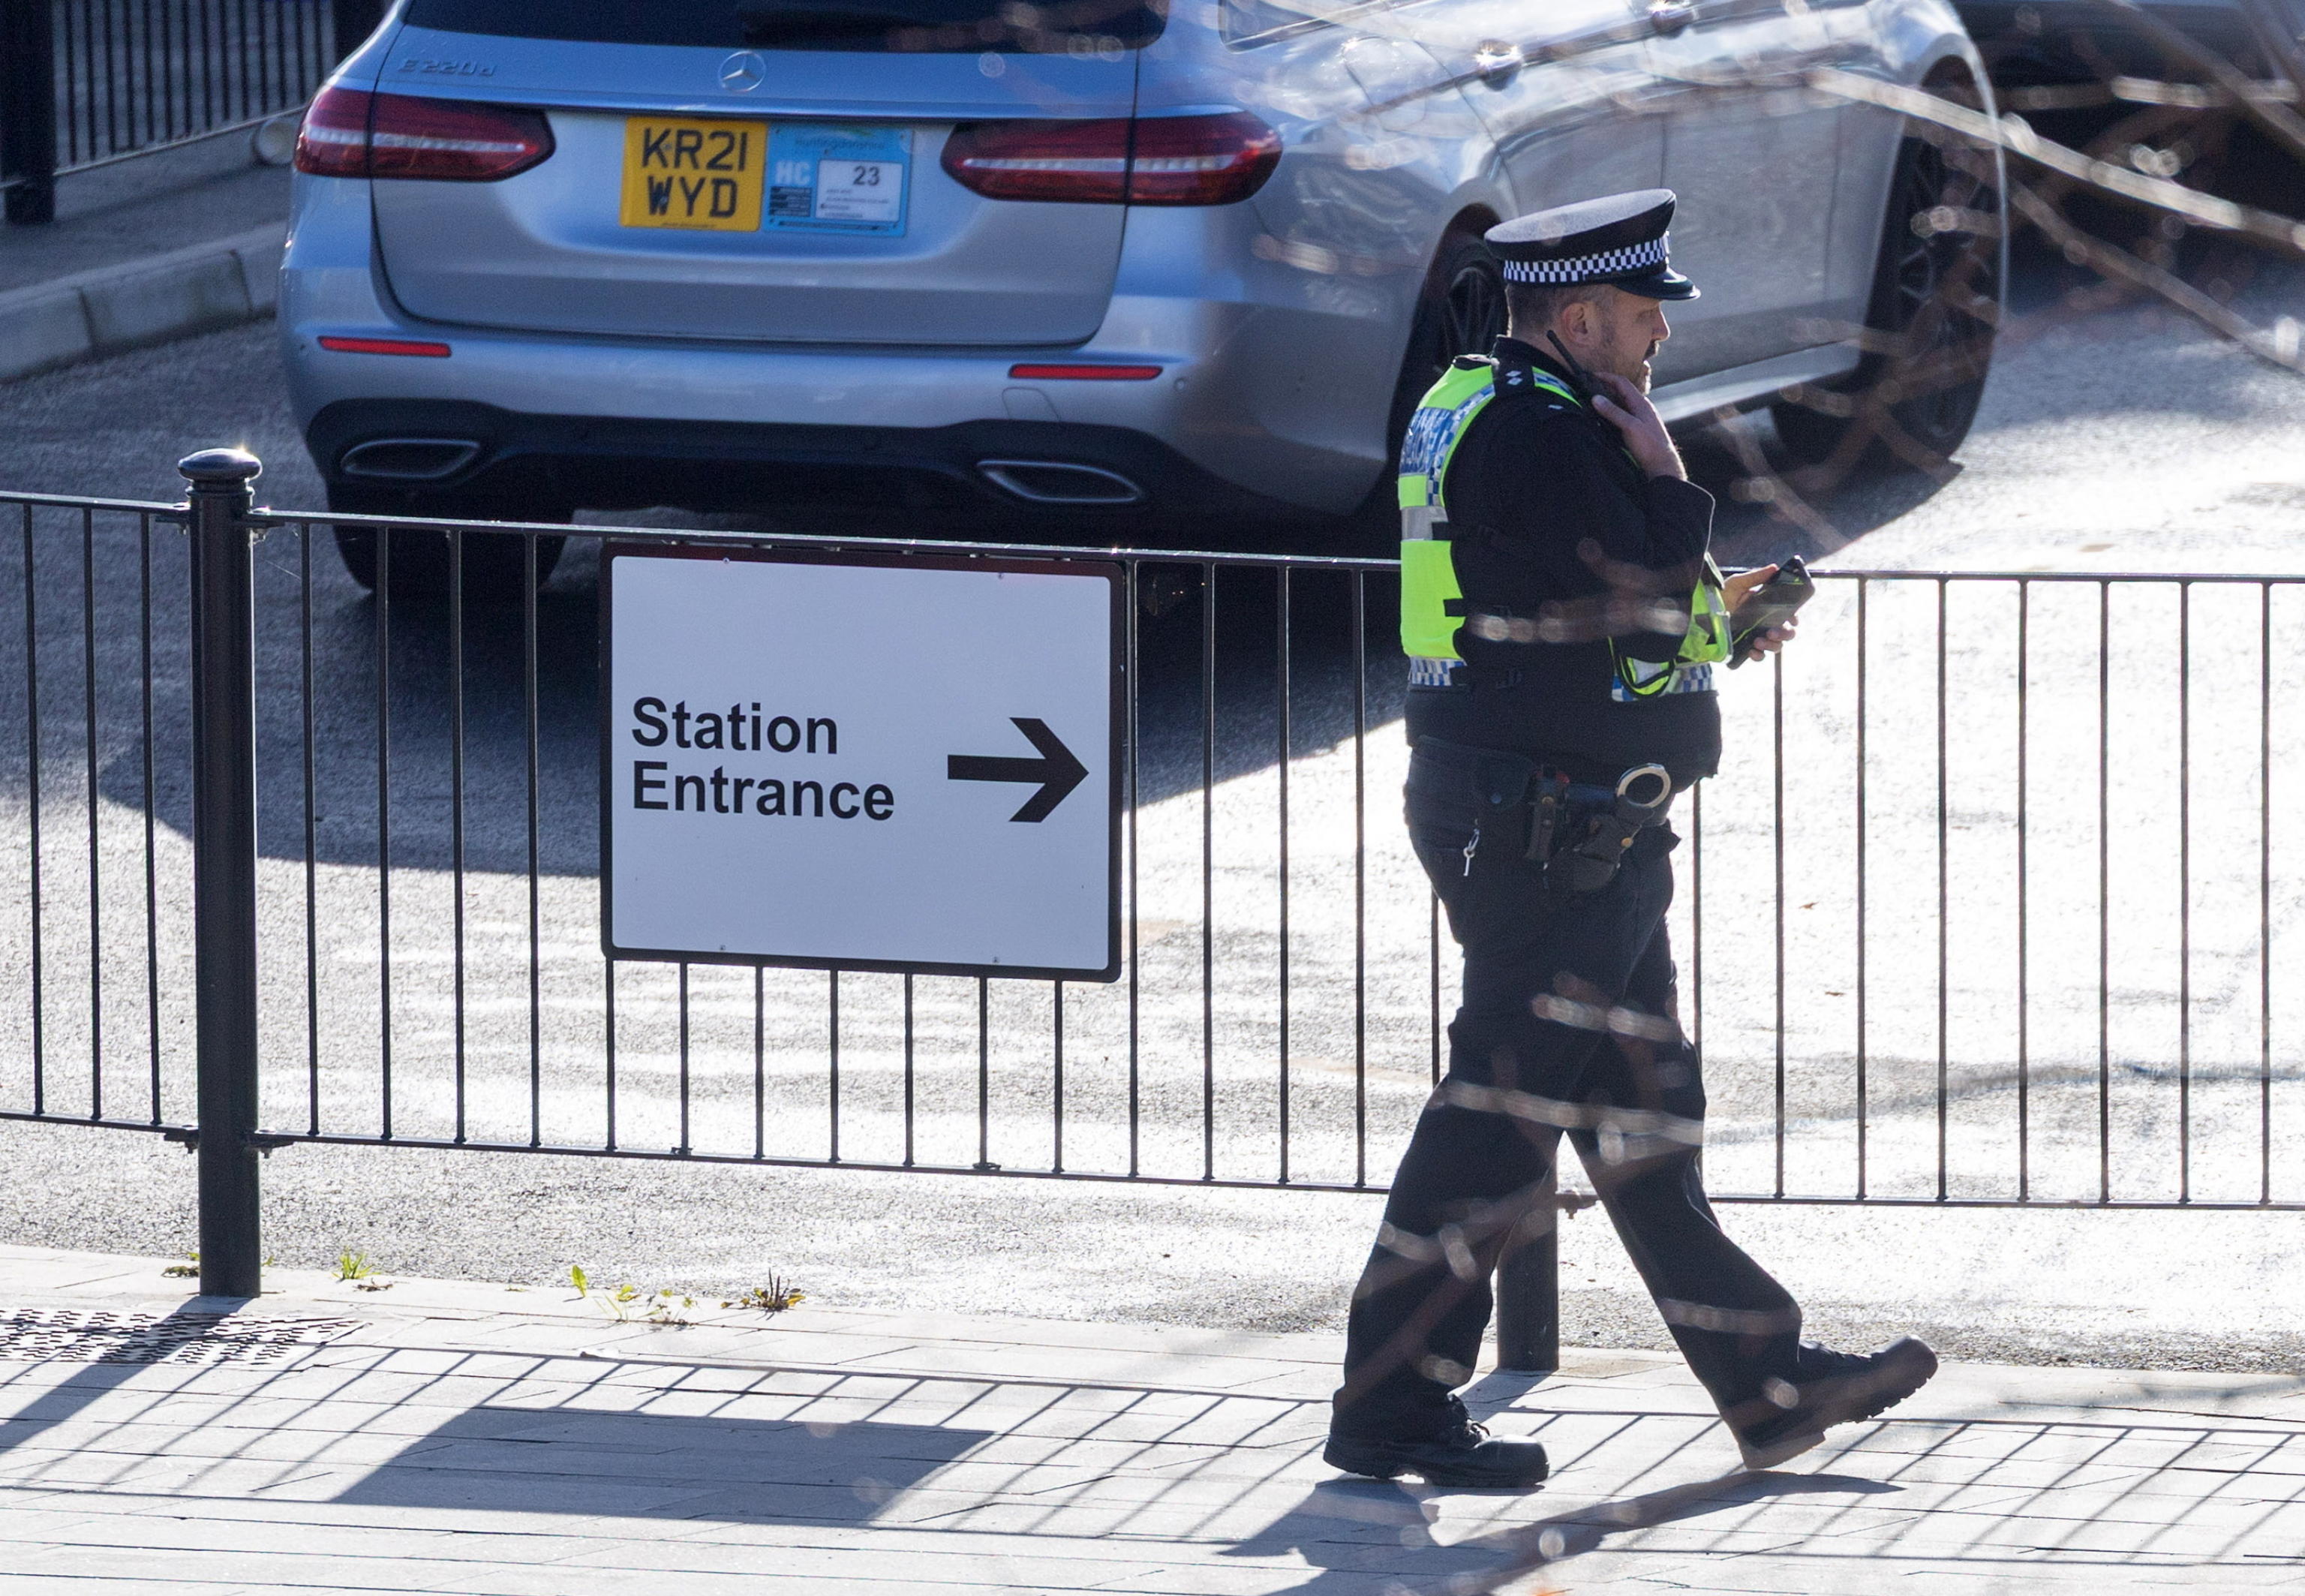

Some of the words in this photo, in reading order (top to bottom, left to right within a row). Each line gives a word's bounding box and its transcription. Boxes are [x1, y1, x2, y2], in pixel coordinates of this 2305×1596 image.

[642, 128, 748, 172] KR21
[774, 160, 811, 185] HC
[853, 165, 880, 186] 23
[648, 175, 738, 218] WYD
[632, 696, 839, 755] Station
[633, 761, 895, 821] Entrance
